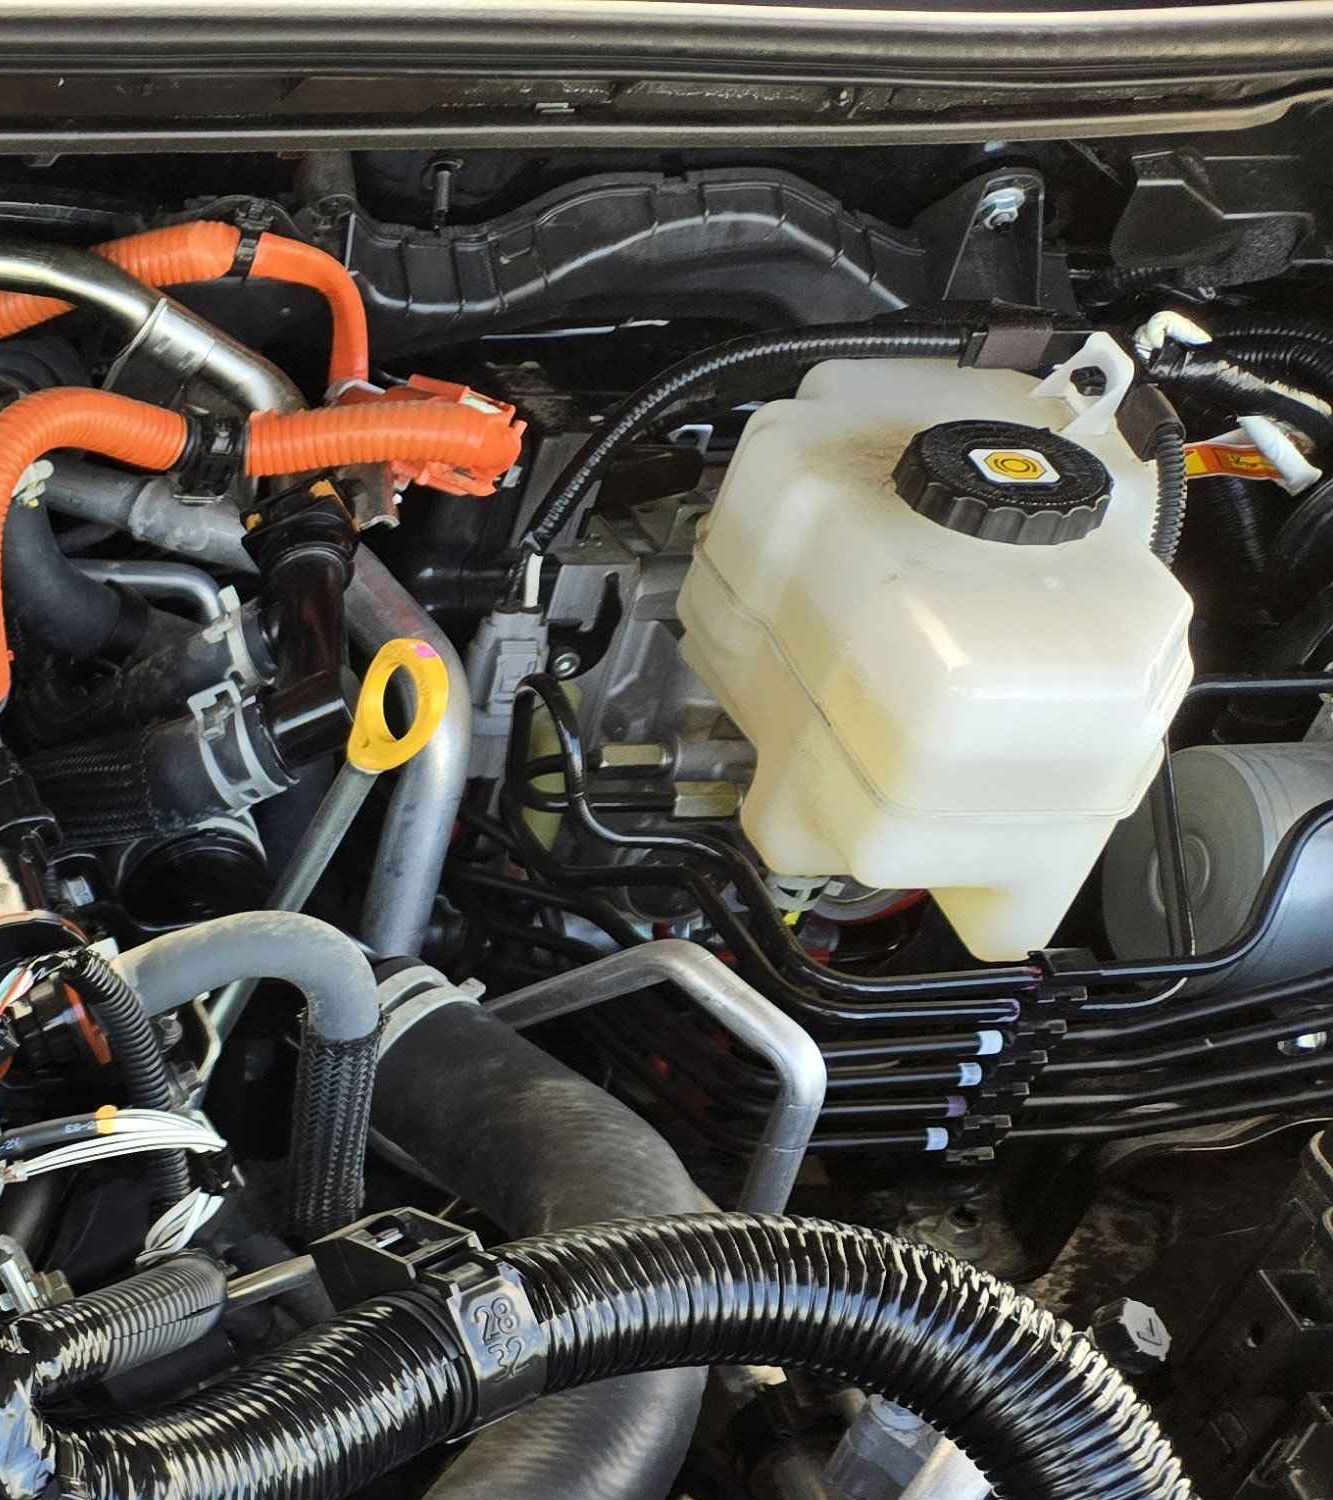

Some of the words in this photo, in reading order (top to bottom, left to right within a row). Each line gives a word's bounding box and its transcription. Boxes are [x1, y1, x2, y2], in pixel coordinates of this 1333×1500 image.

[64, 1120, 97, 1135] ES-2
[473, 1296, 522, 1347] 28
[488, 1335, 531, 1383] 32
